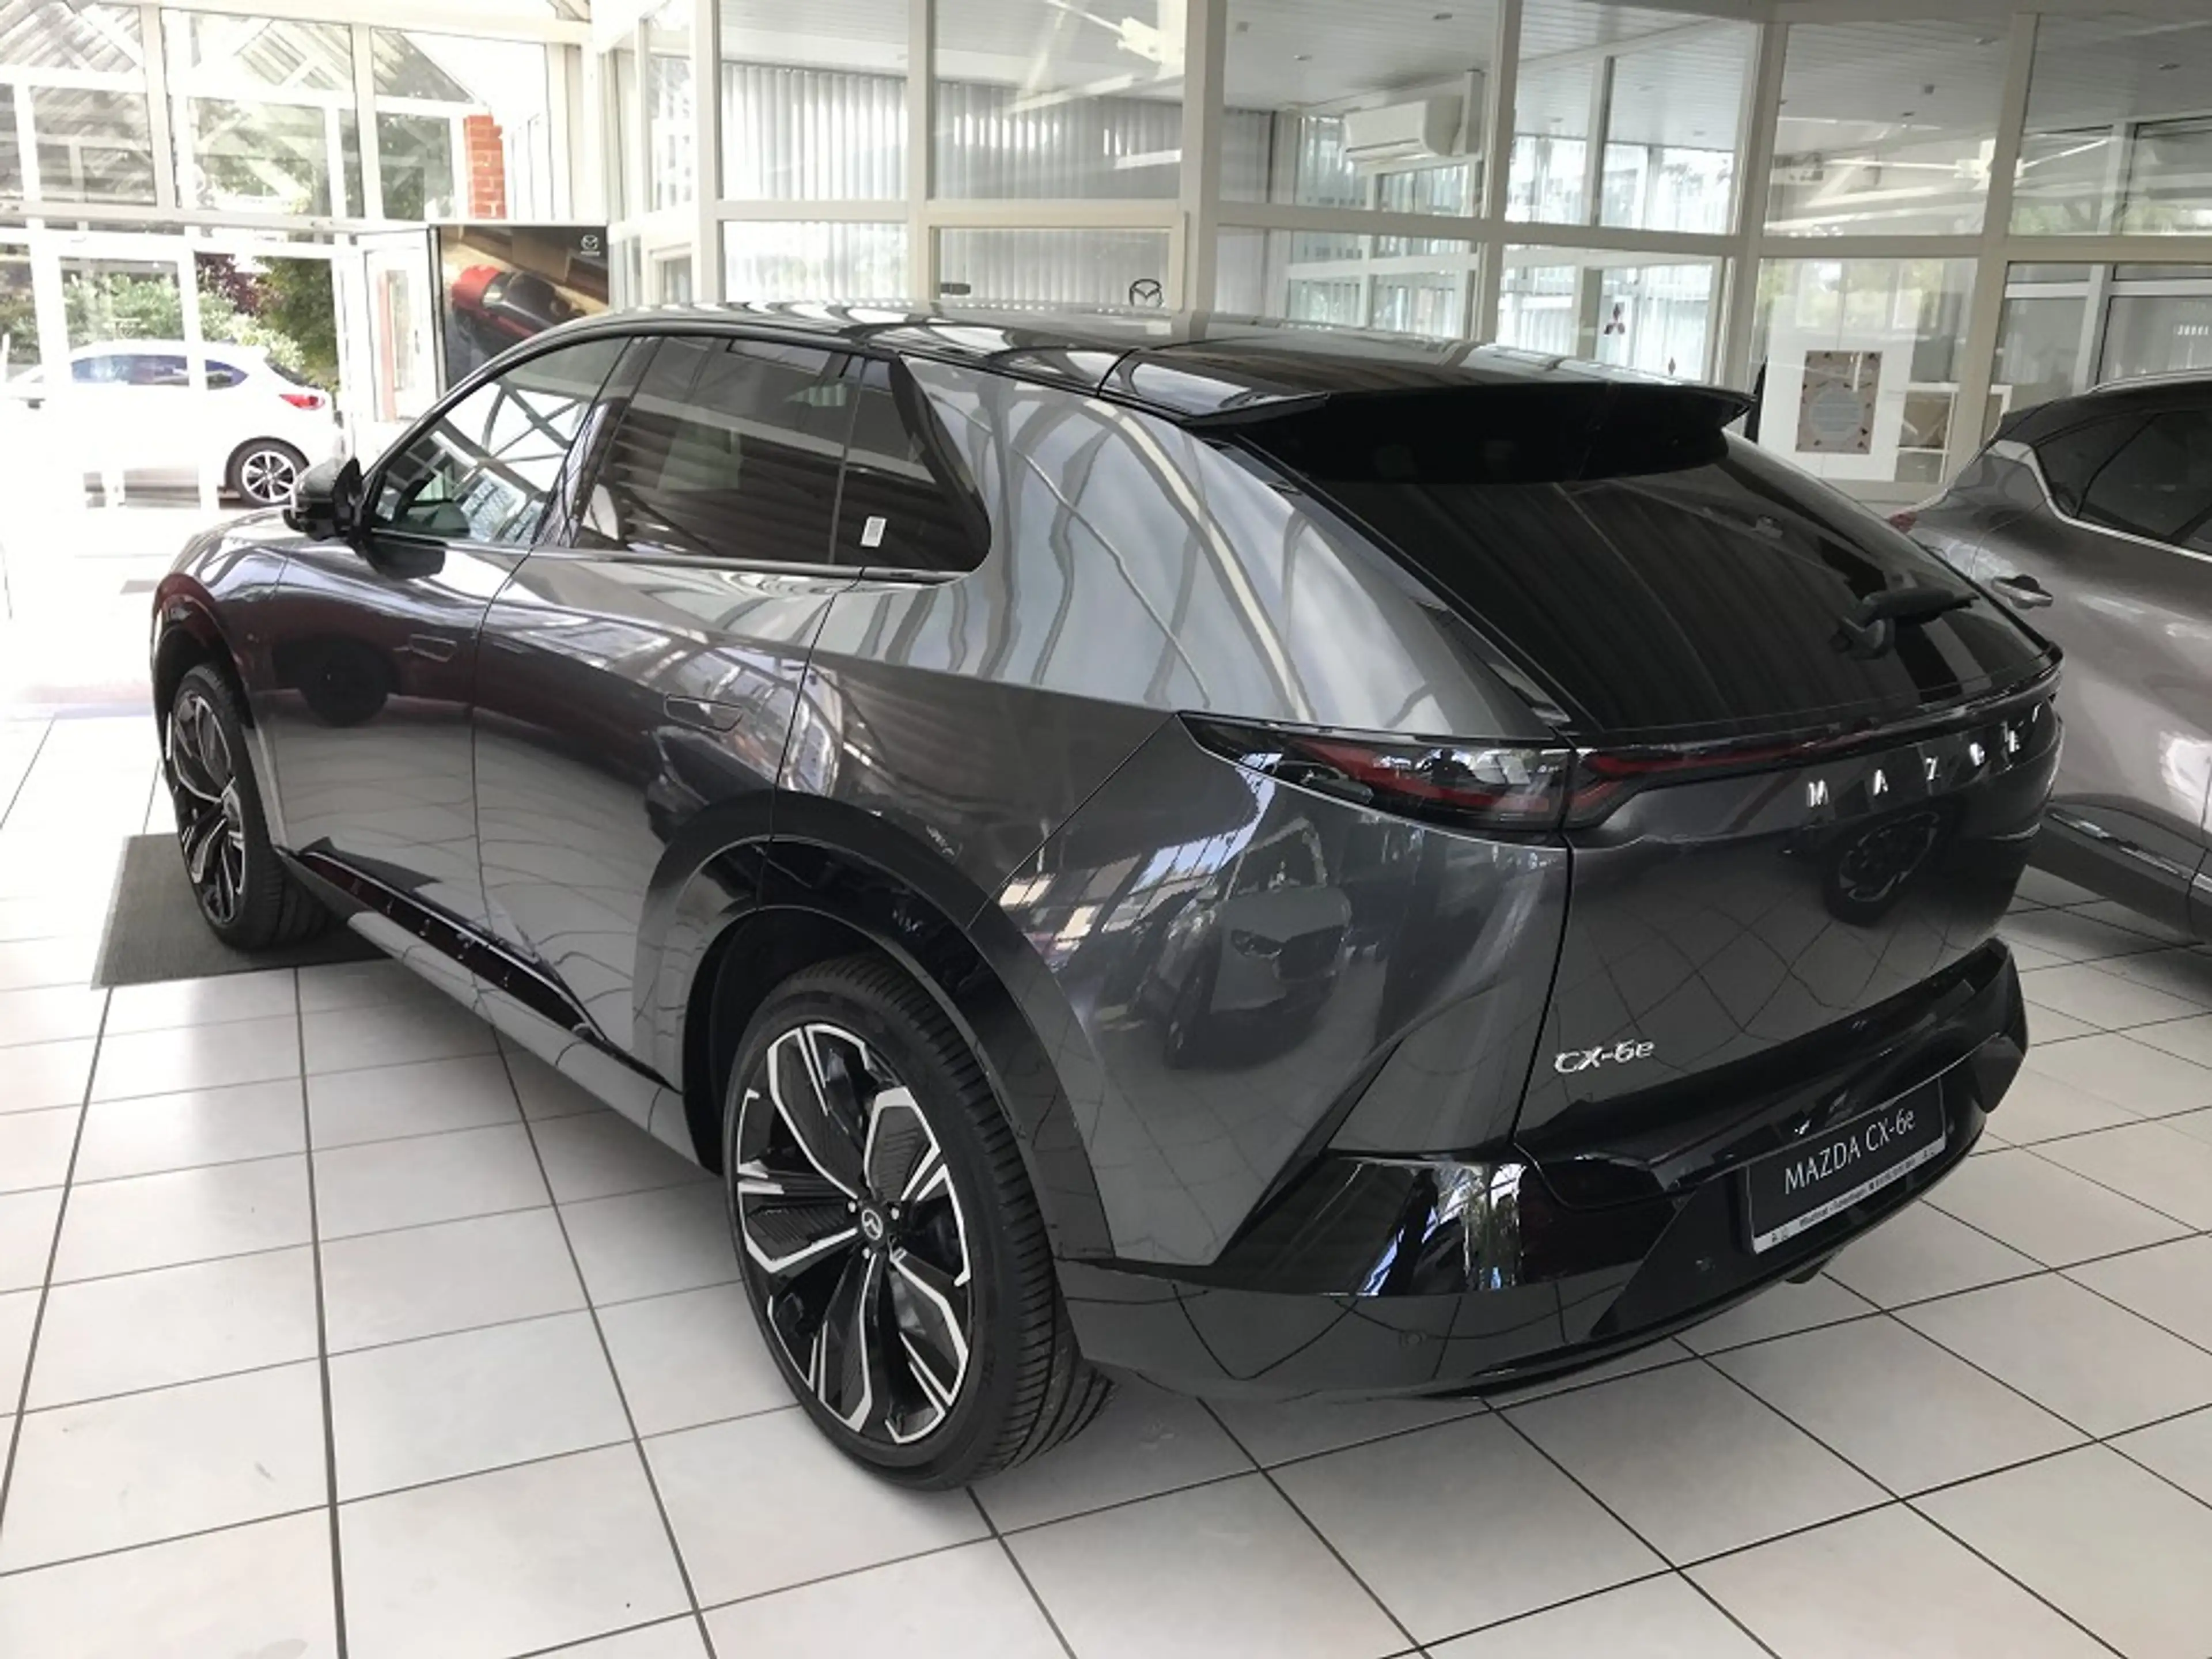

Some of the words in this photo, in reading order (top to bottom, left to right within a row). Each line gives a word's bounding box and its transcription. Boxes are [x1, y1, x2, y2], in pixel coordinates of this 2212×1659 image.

[1554, 1039, 1655, 1073] CX-6e
[1785, 1135, 1861, 1195] MAZDA
[1867, 1108, 1915, 1152] CX-6e
